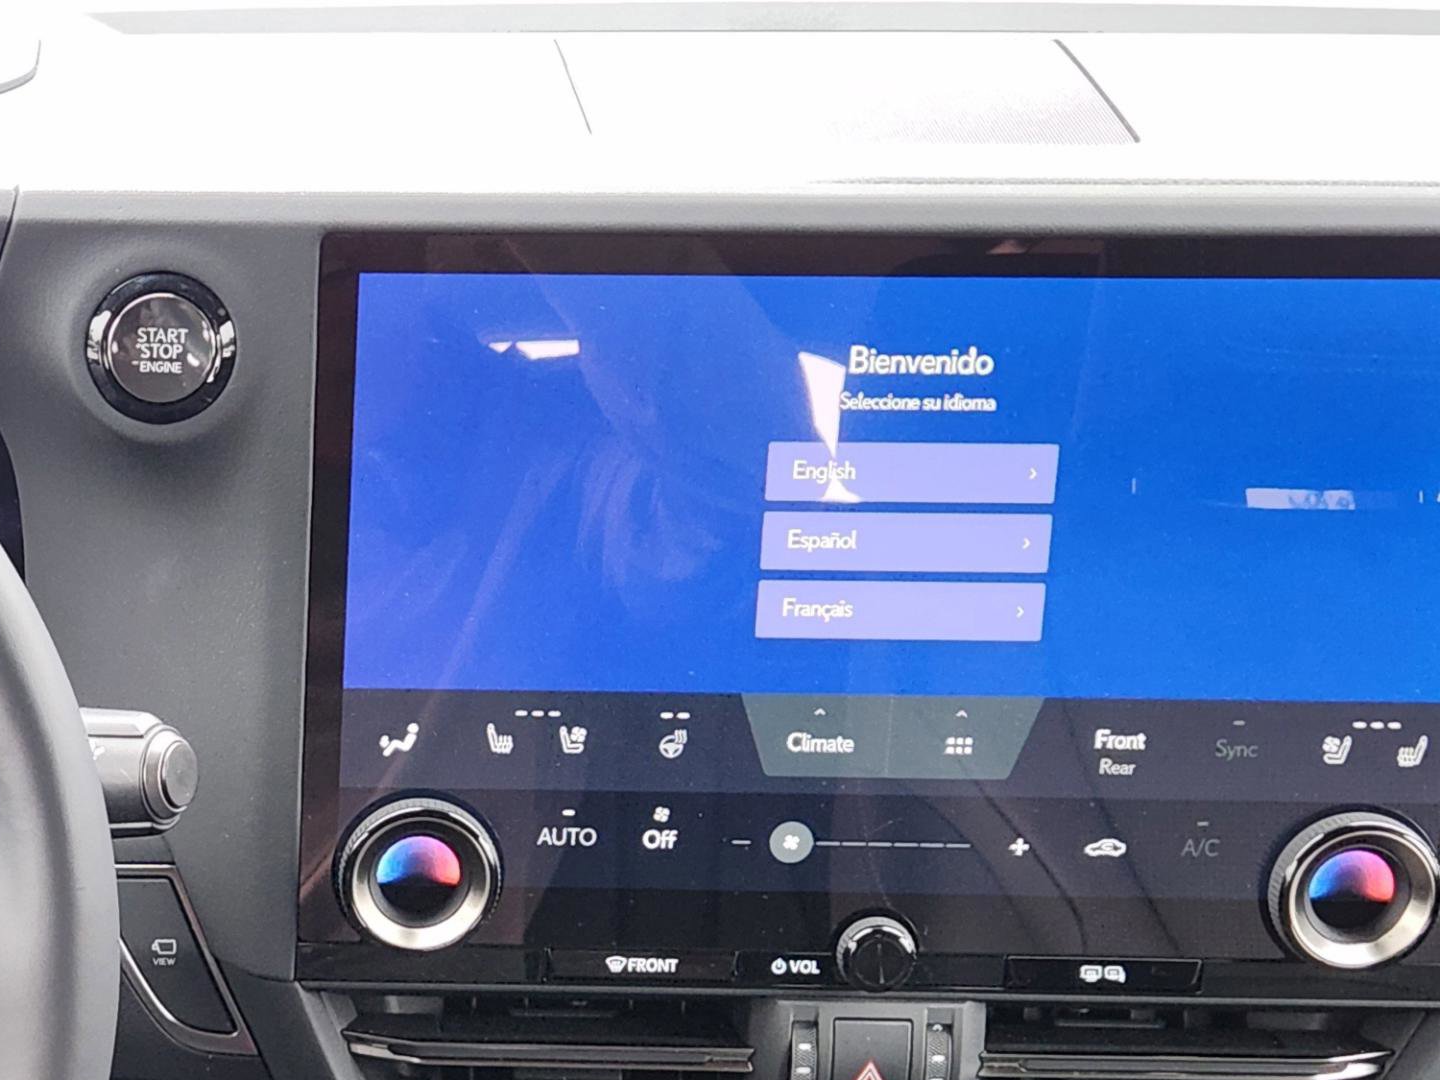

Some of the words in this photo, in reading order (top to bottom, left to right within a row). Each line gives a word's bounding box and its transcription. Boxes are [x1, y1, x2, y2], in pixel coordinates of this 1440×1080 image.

[137, 328, 188, 343] START
[140, 344, 183, 359] STOP
[848, 345, 995, 375] Bienvenido
[140, 361, 182, 374] ENGINE
[840, 391, 920, 411] Seleccione
[923, 398, 941, 411] su
[943, 393, 997, 411] idioma
[793, 460, 857, 483] English
[787, 528, 858, 551] Español
[782, 597, 854, 622] Français
[787, 732, 855, 753] Climate
[1094, 730, 1146, 751] Front
[1215, 740, 1258, 761] Sync
[1099, 758, 1136, 776] Rear
[537, 827, 597, 846] AUTO
[642, 828, 678, 850] Off
[1182, 838, 1220, 858] A/C
[153, 957, 176, 967] VIEW
[627, 957, 679, 973] FRONT
[790, 959, 820, 974] VOL
